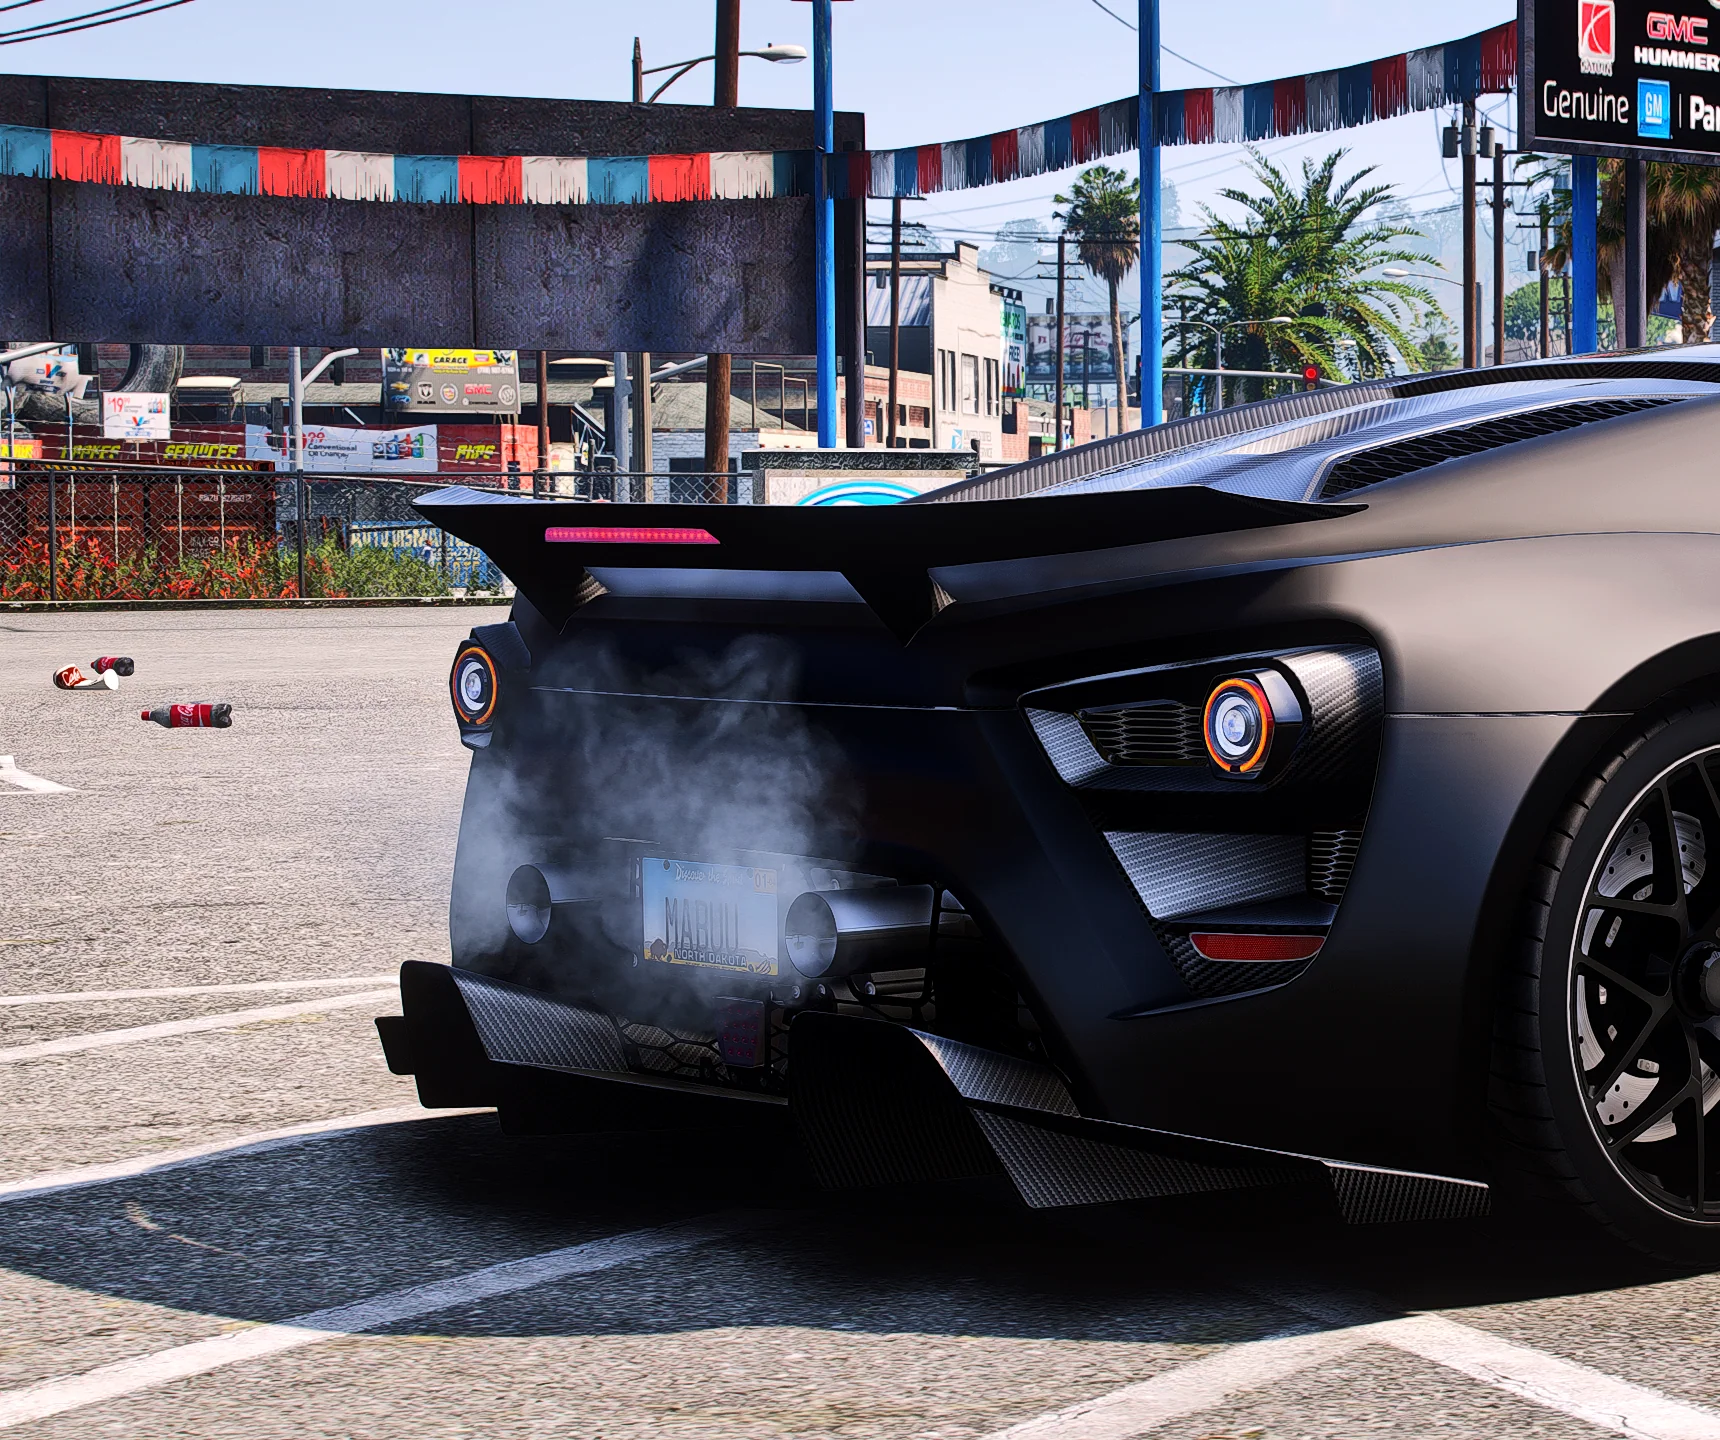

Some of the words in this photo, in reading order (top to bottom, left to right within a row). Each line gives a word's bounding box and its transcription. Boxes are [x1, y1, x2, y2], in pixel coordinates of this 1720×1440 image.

[1646, 11, 1709, 45] GMC
[1634, 45, 1719, 72] HUMMER
[1543, 79, 1630, 124] Genuine
[1645, 91, 1663, 119] GM
[433, 356, 468, 364] GARAGE
[464, 383, 493, 395] GMC
[163, 444, 239, 460] SERVICES
[308, 443, 358, 451] Conventional
[675, 862, 706, 882] Discover
[706, 866, 721, 884] the
[674, 948, 706, 962] NORTH
[708, 952, 748, 967] DAKOTA
